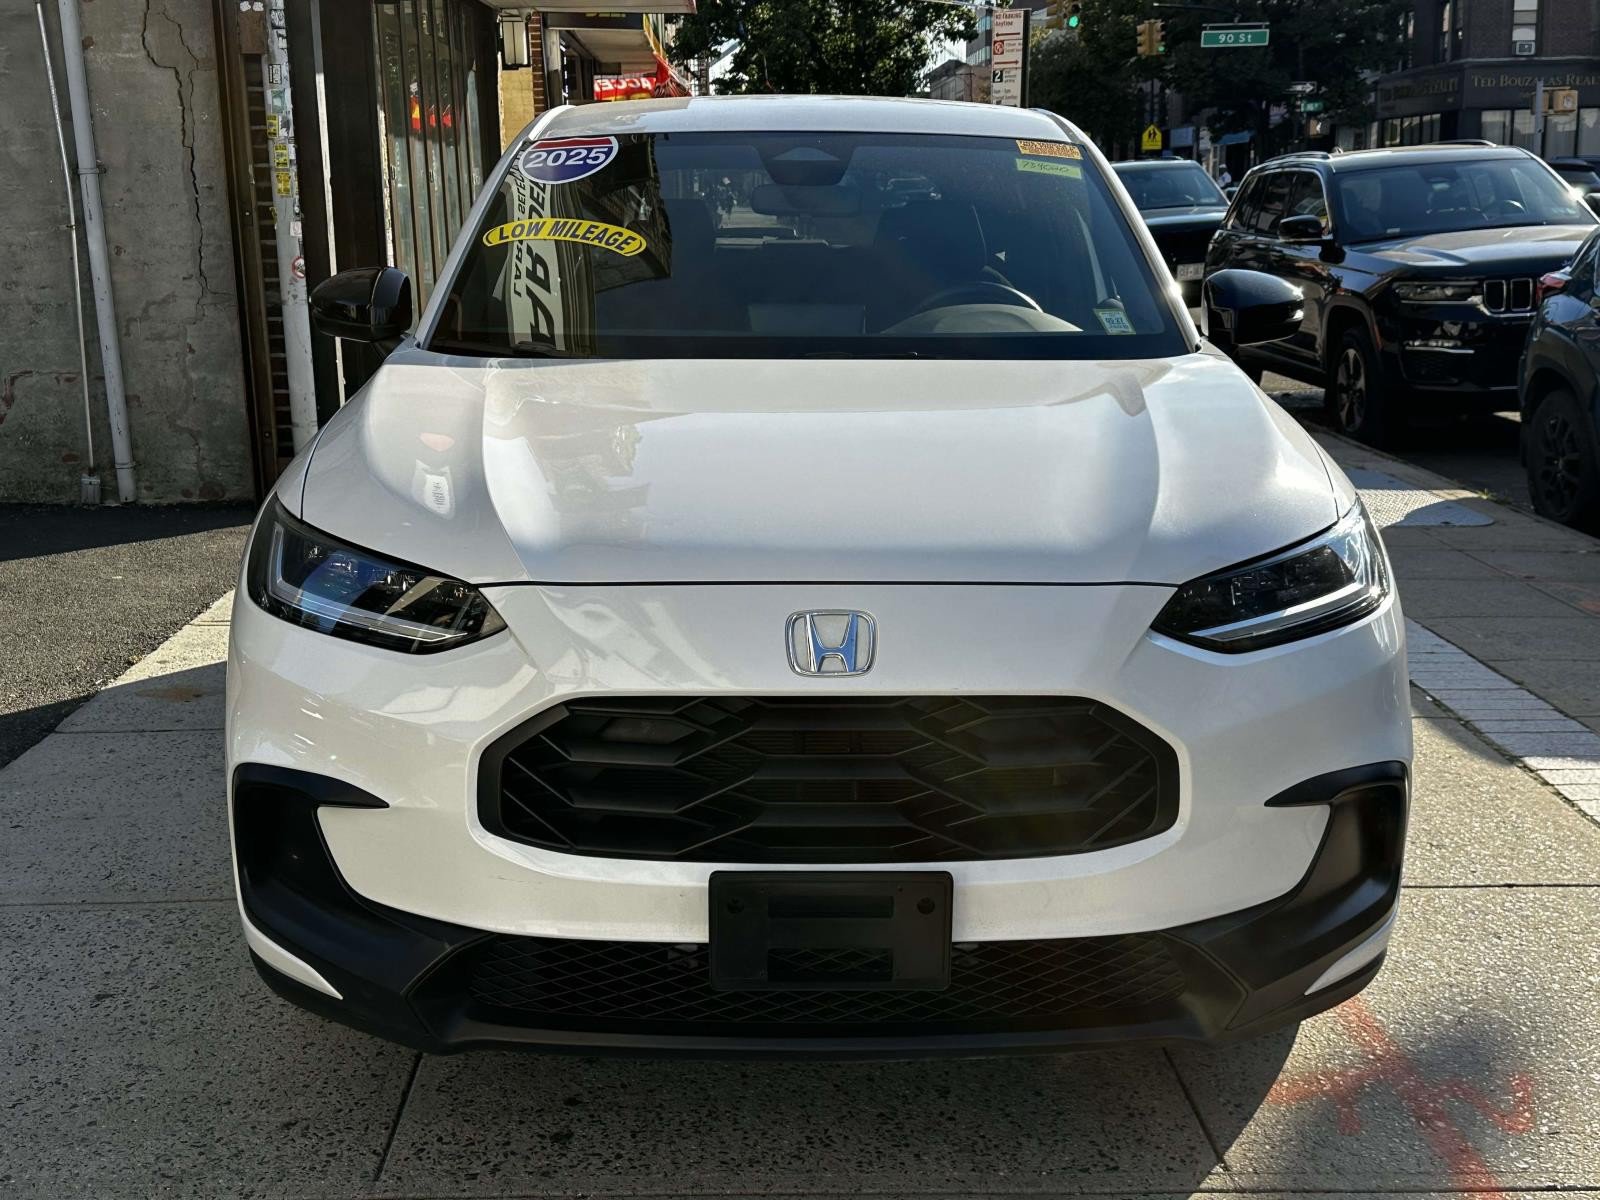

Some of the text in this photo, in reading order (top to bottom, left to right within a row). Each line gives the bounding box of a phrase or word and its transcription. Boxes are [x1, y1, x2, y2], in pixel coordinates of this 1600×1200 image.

[1218, 33, 1252, 43] 90 St
[526, 148, 607, 167] 2025
[498, 221, 637, 251] LOW MILEAGE
